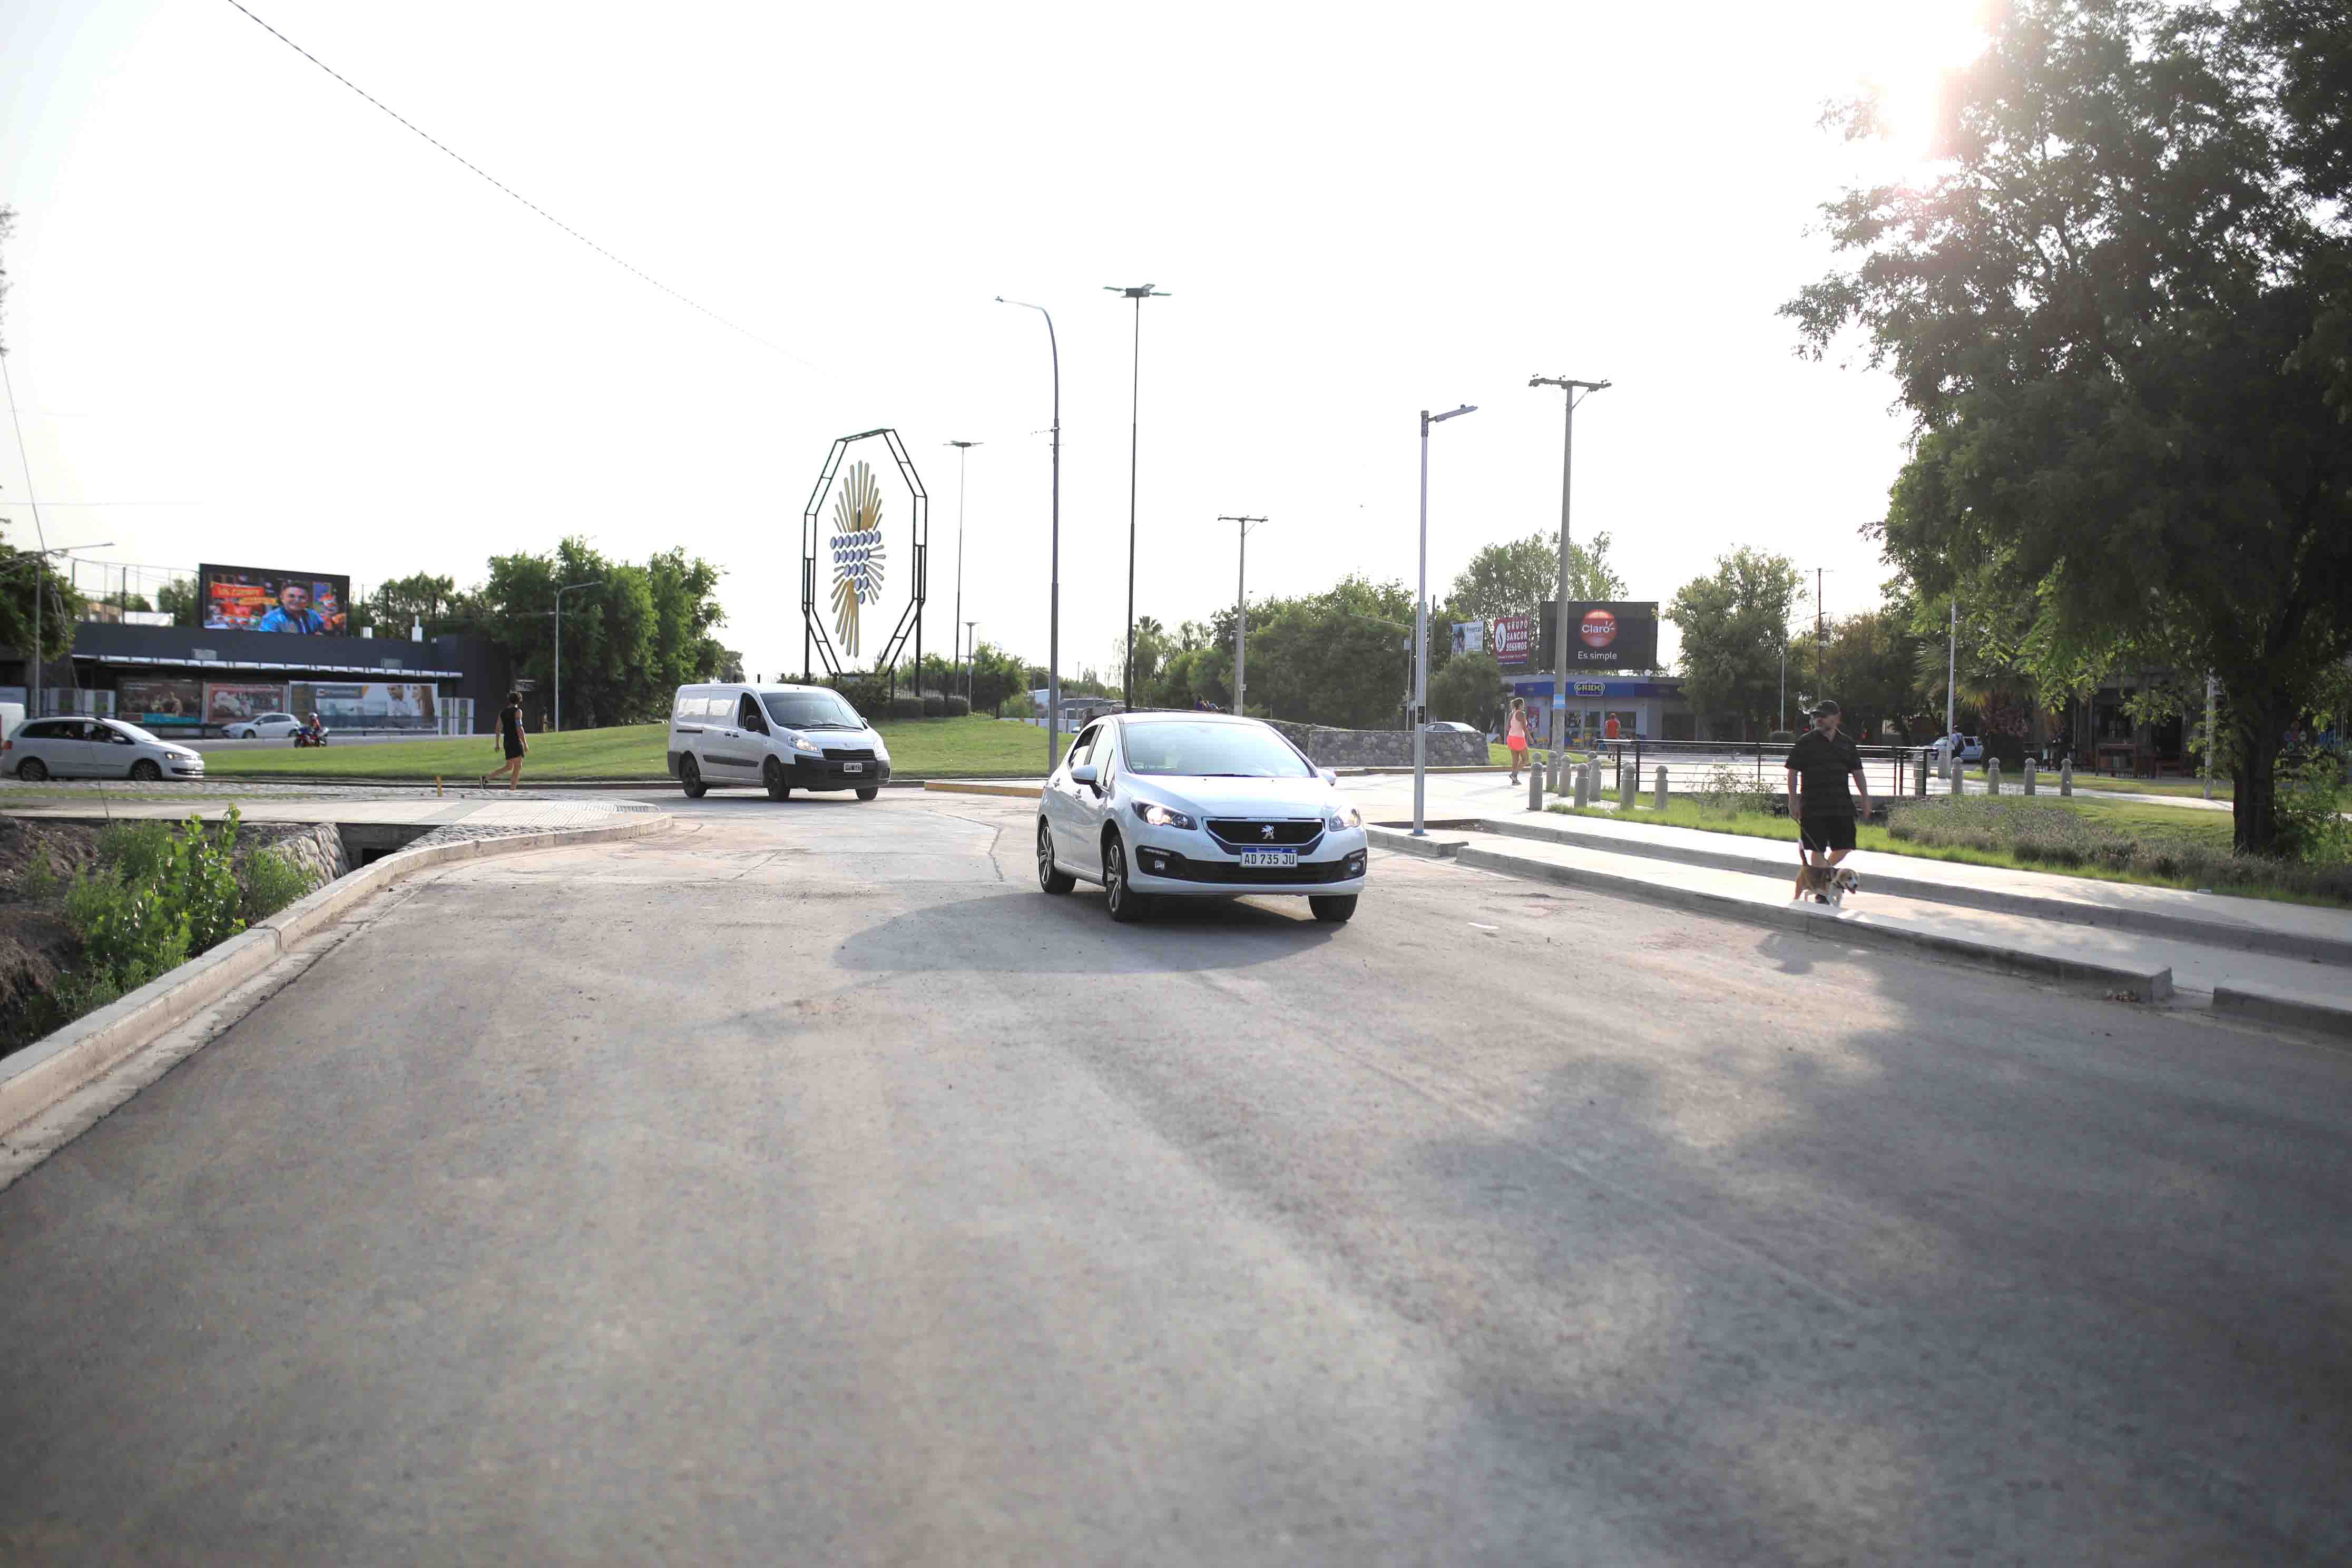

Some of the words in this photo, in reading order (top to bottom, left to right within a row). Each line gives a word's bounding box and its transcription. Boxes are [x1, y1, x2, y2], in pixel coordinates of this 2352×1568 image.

[1507, 620, 1528, 630] GRUPO
[1582, 623, 1611, 633] Claro
[1506, 632, 1527, 641] SANCOR
[1506, 642, 1527, 651] SEGUROS
[1590, 650, 1617, 662] simple
[1244, 854, 1257, 865] AD
[1260, 854, 1279, 865] 735
[1282, 854, 1295, 865] JU
